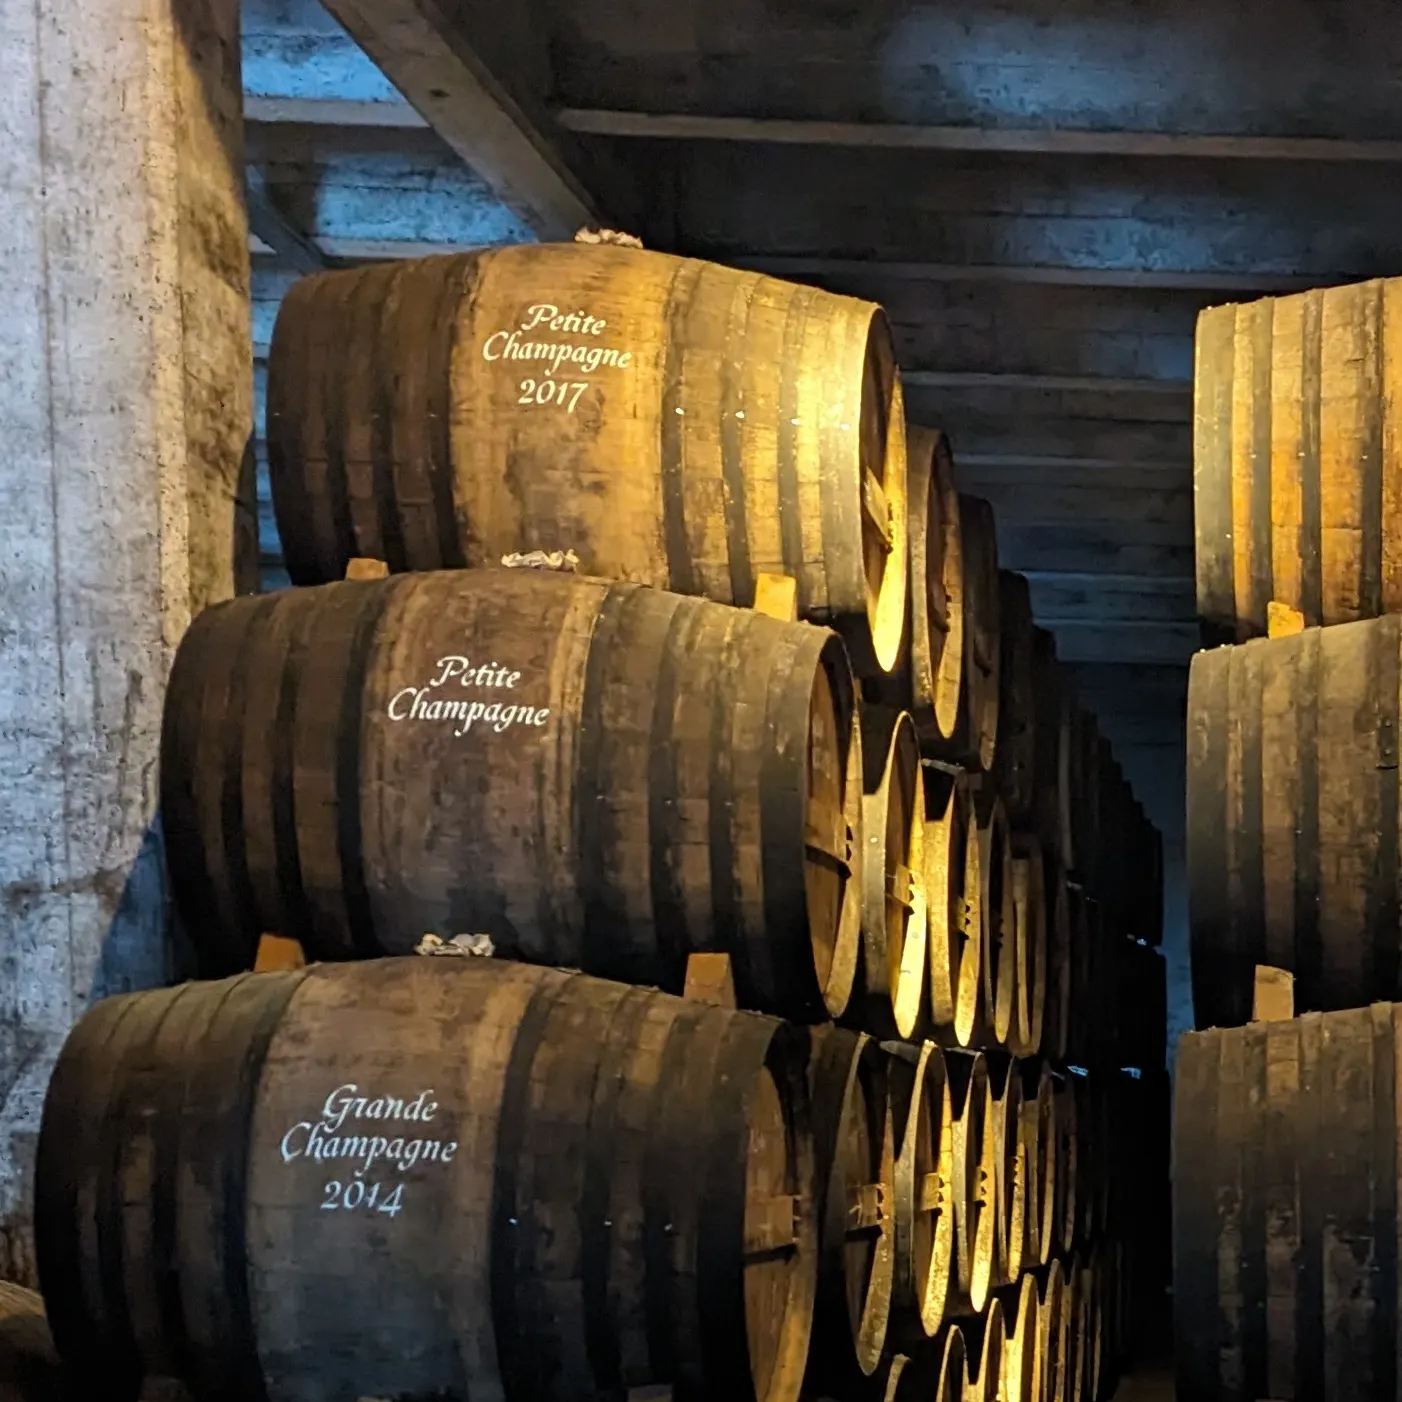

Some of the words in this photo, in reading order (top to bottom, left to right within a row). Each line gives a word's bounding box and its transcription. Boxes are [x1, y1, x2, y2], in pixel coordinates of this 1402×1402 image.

[521, 304, 607, 335] Petite
[483, 331, 632, 376] Champagne
[518, 379, 588, 414] 2017
[430, 656, 521, 688] Petite
[388, 687, 550, 736] Champagne
[323, 1084, 438, 1133] Grande
[281, 1121, 458, 1177] Champagne
[321, 1181, 405, 1217] 2014
